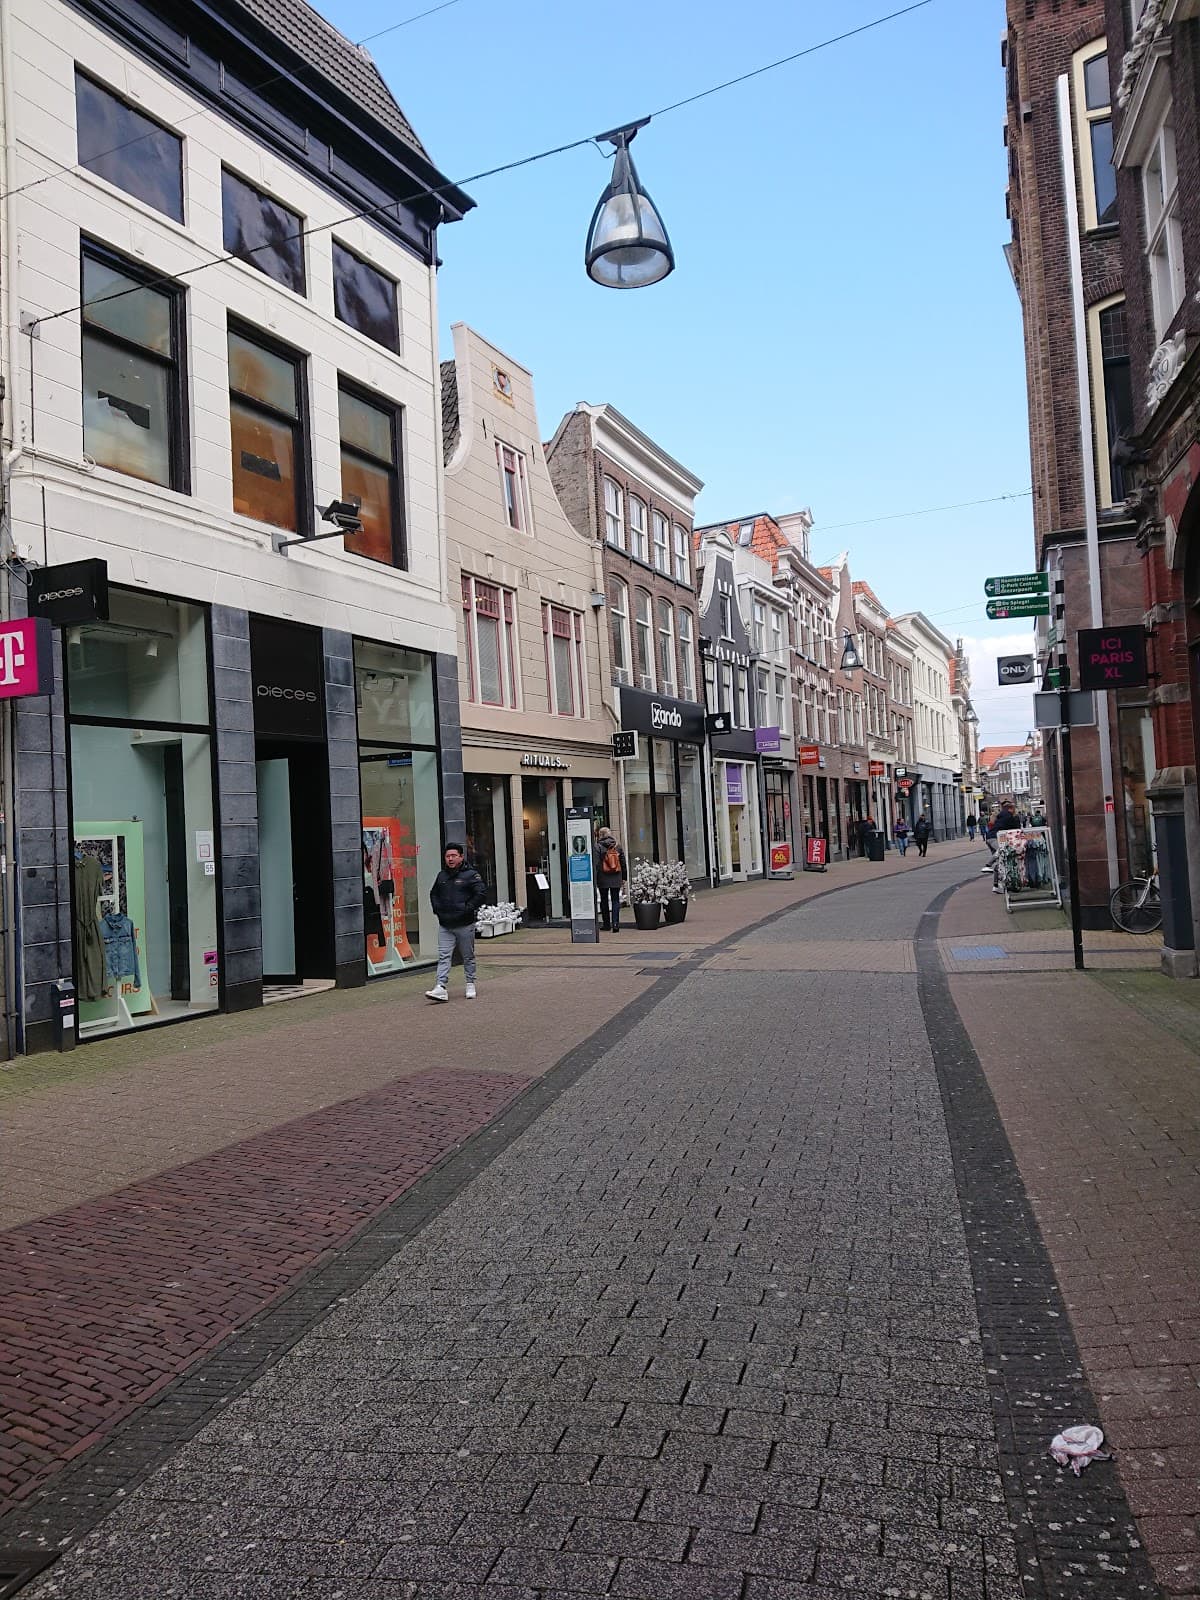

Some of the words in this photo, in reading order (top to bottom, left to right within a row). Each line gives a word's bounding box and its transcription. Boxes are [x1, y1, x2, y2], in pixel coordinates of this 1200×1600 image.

[38, 587, 84, 603] pieces
[1101, 637, 1122, 650] ICI
[1090, 651, 1134, 665] PARIS
[1000, 664, 1031, 675] ONLY
[1104, 666, 1123, 679] XL
[257, 685, 317, 702] pieces
[813, 840, 821, 863] SALE
[205, 863, 214, 873] 55
